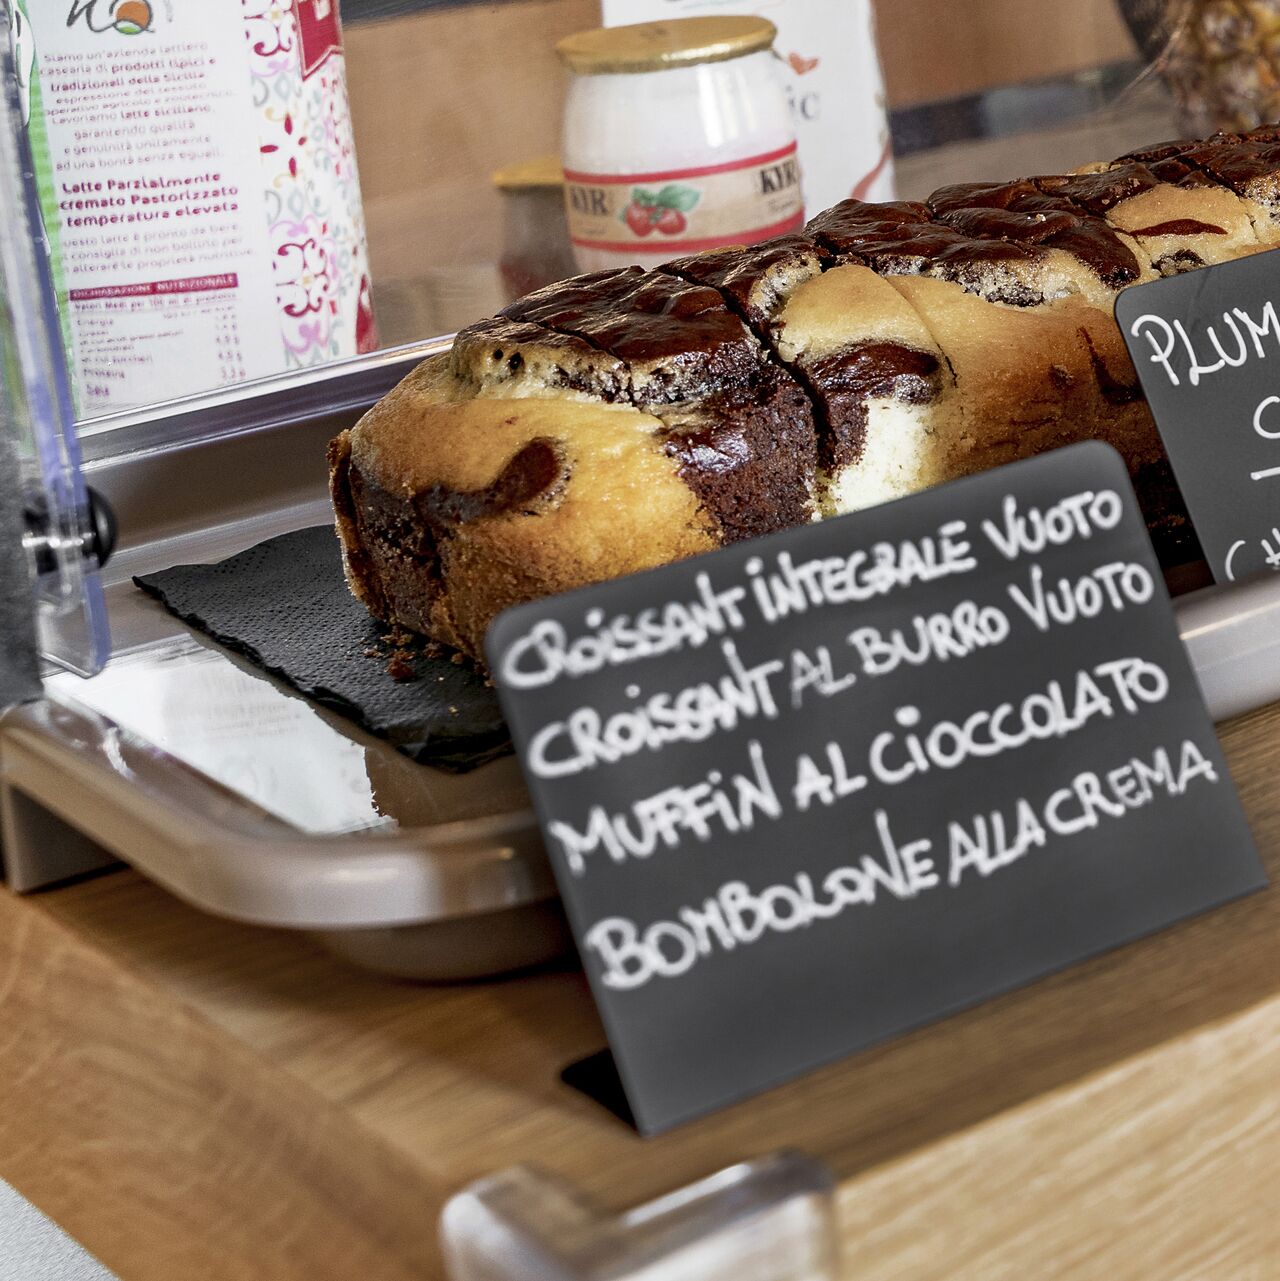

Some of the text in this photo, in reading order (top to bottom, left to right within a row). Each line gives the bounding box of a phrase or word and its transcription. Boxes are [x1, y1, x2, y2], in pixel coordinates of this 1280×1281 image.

[981, 489, 1123, 560] VUOTO
[789, 648, 856, 709] AL
[849, 601, 1010, 678] BURRO
[1009, 561, 1154, 630] VUOTO
[794, 742, 868, 811] AL
[587, 809, 939, 993] BOMBOLONE
